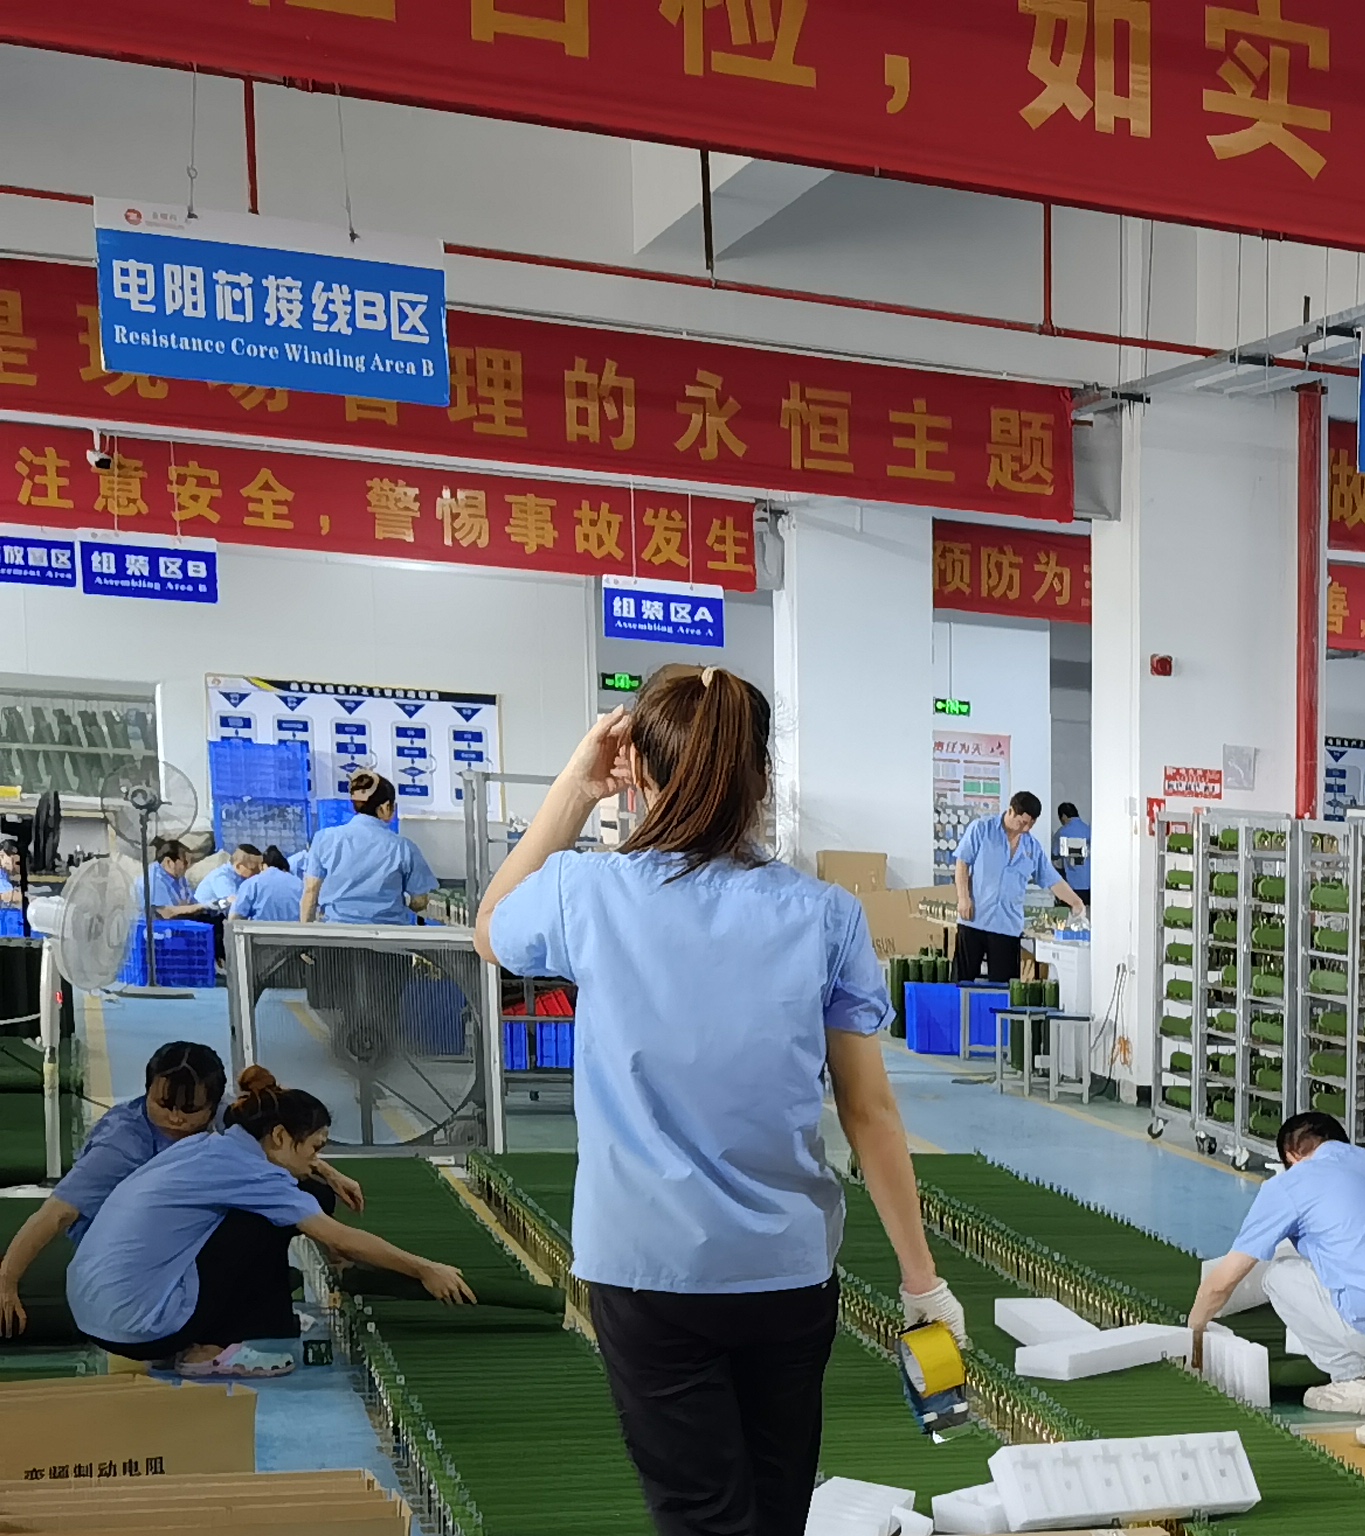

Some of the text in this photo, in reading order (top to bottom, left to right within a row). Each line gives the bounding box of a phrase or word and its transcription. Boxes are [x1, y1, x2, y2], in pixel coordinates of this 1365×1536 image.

[111, 258, 430, 344] 电阻芯接线B区
[113, 324, 435, 378] Resistance Core Winding Area B
[91, 550, 208, 579] 组装区B
[934, 540, 1091, 606] 预防为
[612, 596, 714, 624] 组装区A
